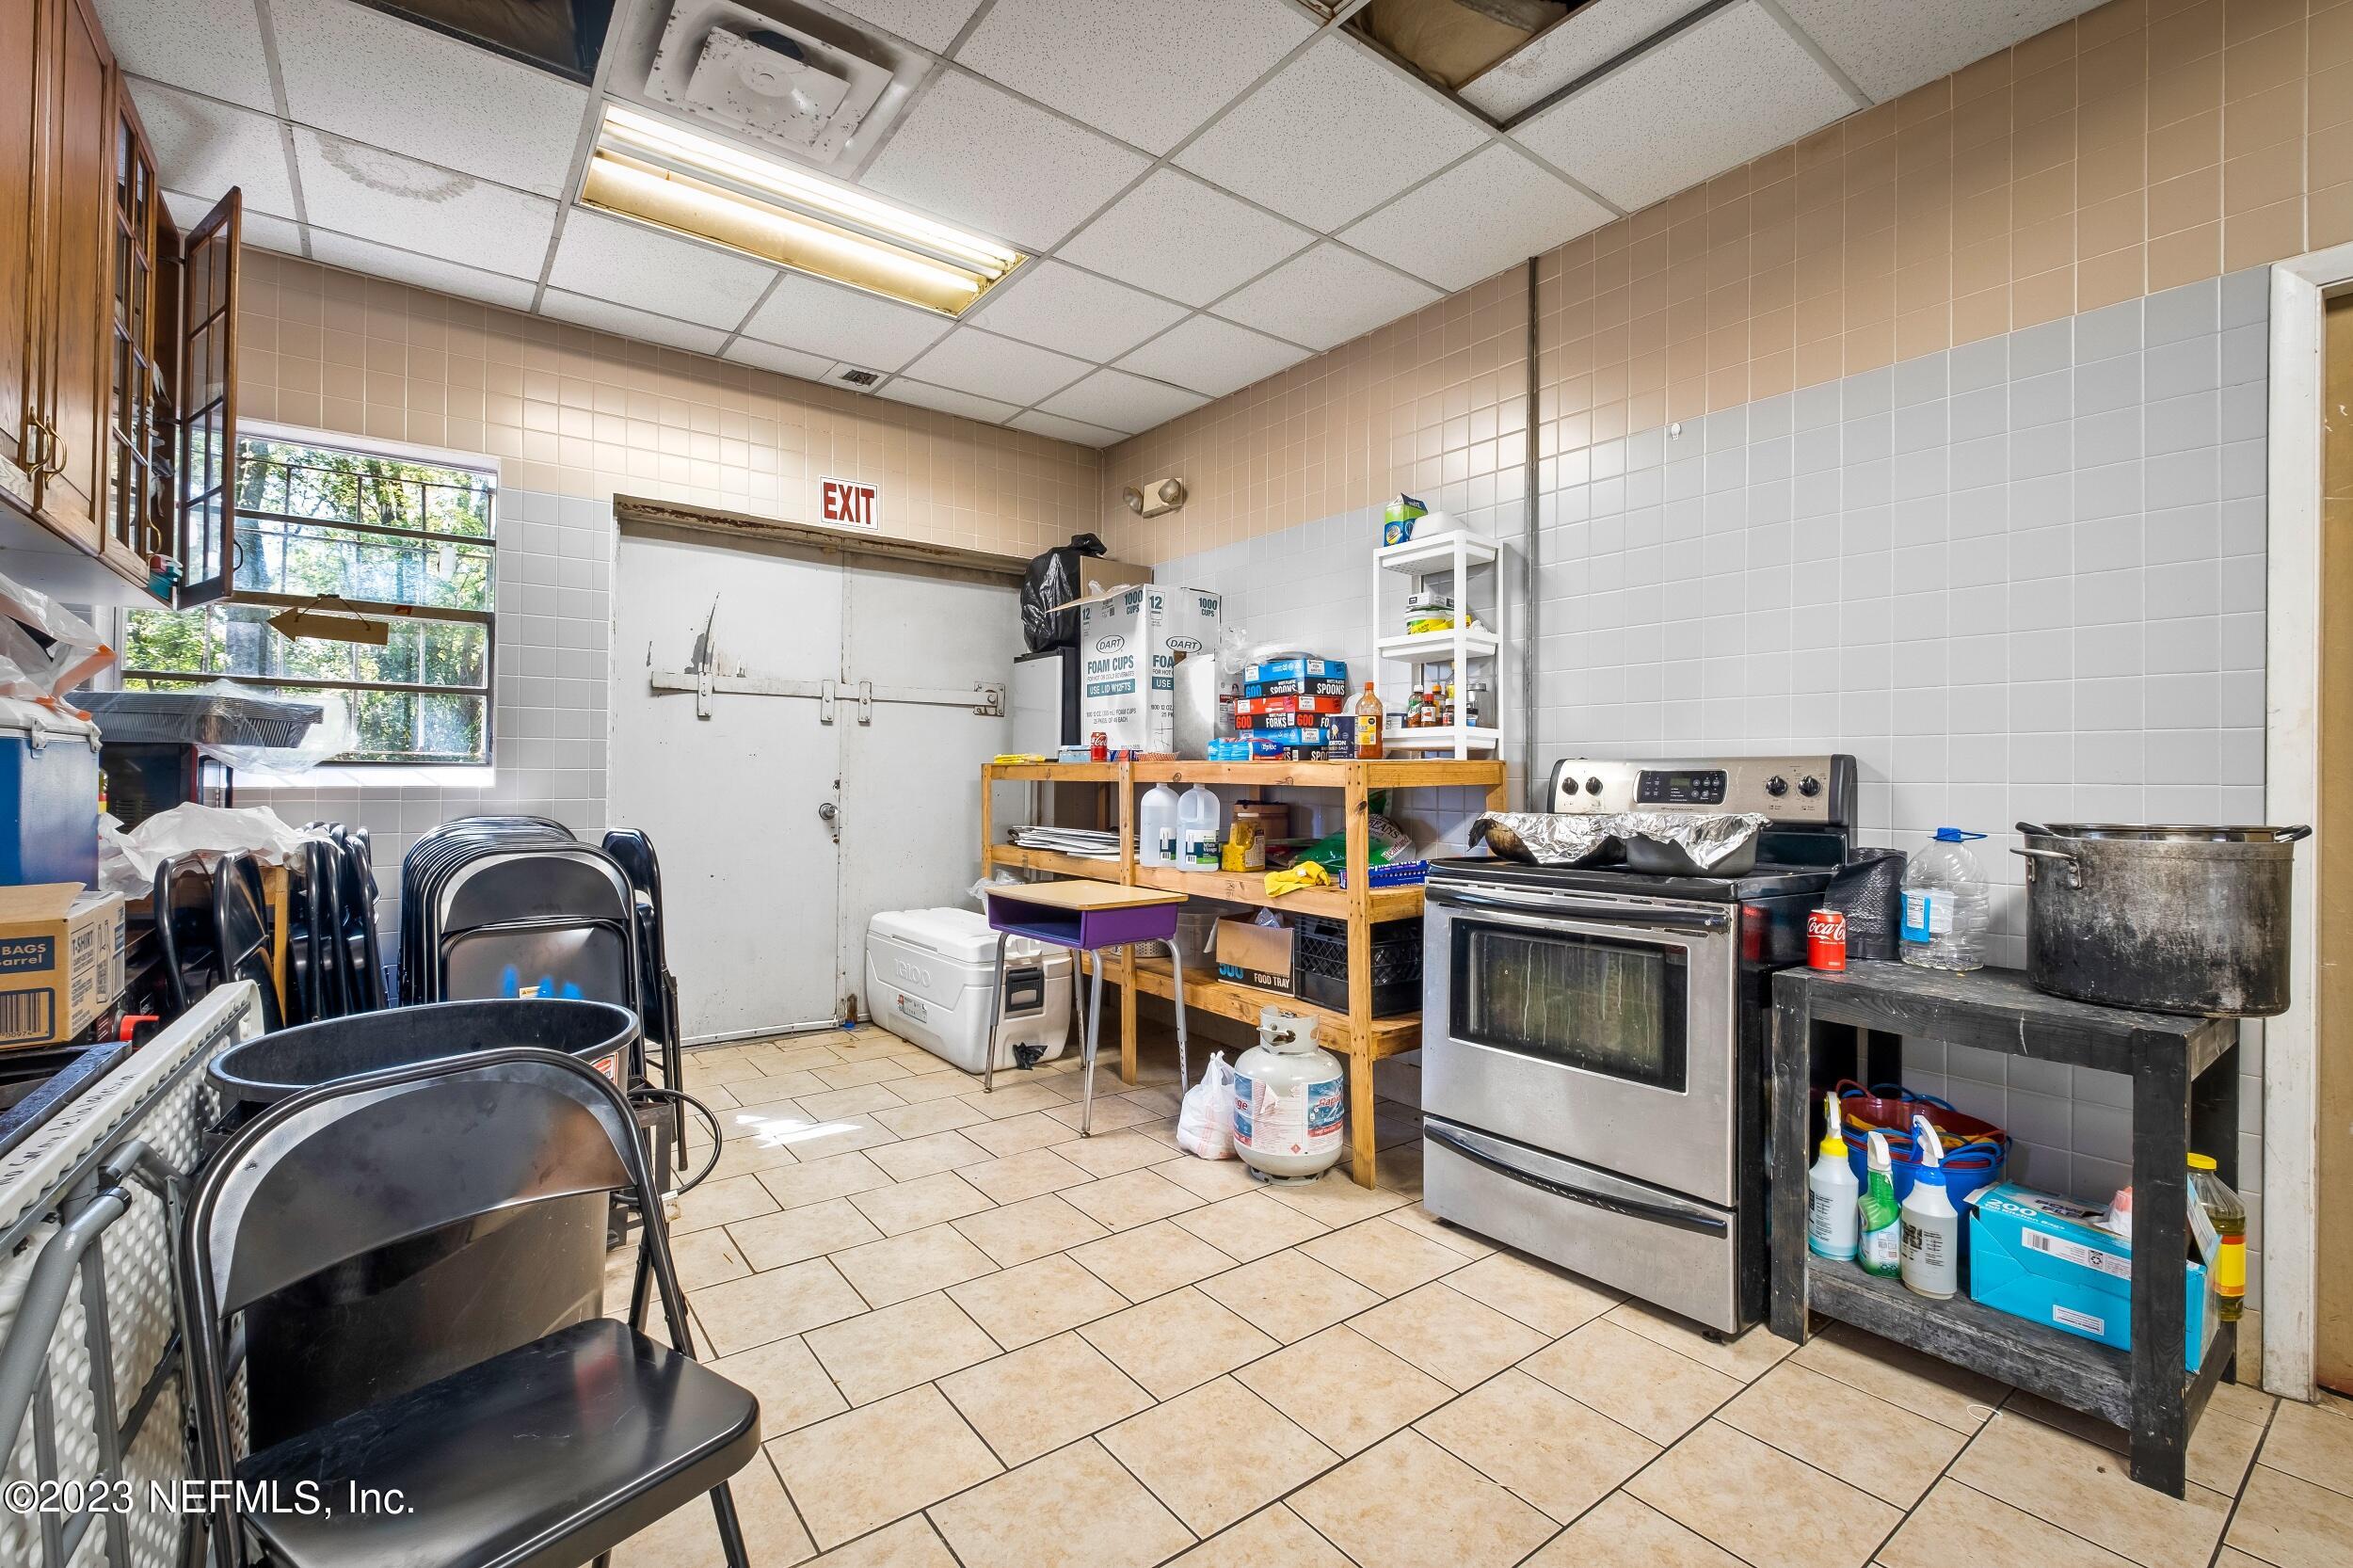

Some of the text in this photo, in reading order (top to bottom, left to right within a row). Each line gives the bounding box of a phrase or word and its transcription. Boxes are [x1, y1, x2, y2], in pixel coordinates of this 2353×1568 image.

[823, 481, 875, 525] EXIT
[1124, 590, 1143, 605] 1000
[1149, 595, 1162, 610] 12
[1198, 597, 1218, 611] 1000
[1082, 607, 1091, 620] 12
[1126, 603, 1140, 616] CUPS
[1201, 608, 1215, 617] CUPS
[1099, 638, 1122, 650] DART
[1170, 639, 1198, 649] DART
[1087, 654, 1134, 675] FOAM CUPS
[1152, 654, 1174, 668] FOA
[1089, 685, 1100, 695] USE
[1101, 684, 1111, 694] LID
[1156, 679, 1172, 688] USE
[1245, 684, 1261, 697] 600
[1317, 682, 1345, 696] SPOONS
[1236, 715, 1253, 729] 600
[1266, 716, 1287, 728] FORKS
[1296, 713, 1314, 727] 600
[1321, 717, 1329, 728] FO
[1382, 835, 1411, 860] Heartland
[2, 943, 46, 955] BAGS
[72, 930, 93, 956] T-SHIRT
[1254, 973, 1289, 989] FOOD TRAY
[1986, 1198, 2038, 1217] 200
[2001, 1208, 2040, 1223] Kitchen
